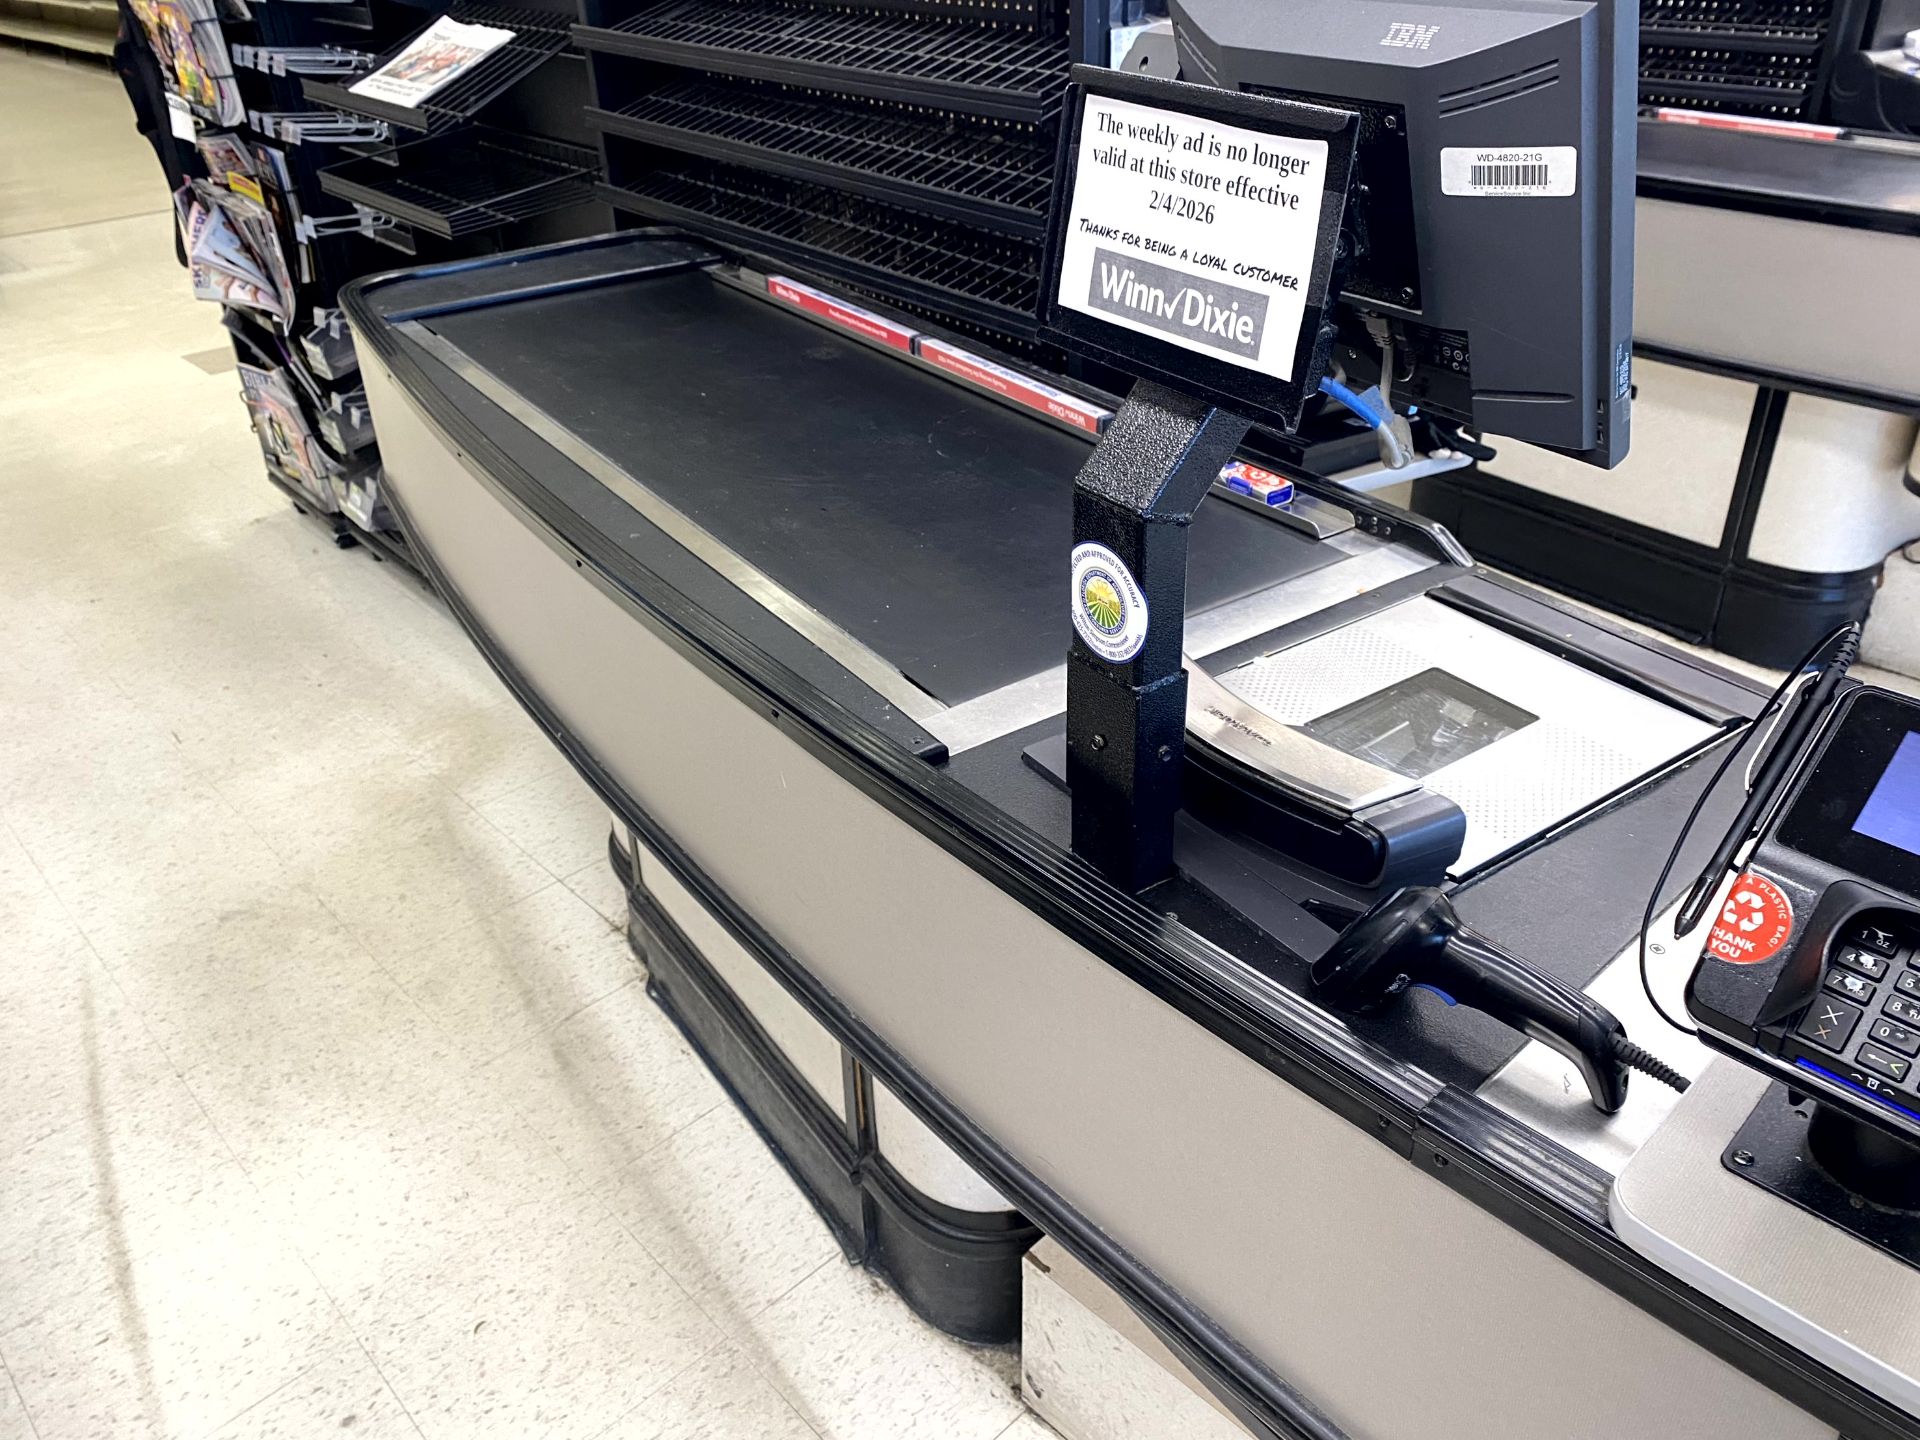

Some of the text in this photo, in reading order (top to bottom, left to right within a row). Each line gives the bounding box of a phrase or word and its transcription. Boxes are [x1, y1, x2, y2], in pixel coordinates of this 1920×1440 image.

[1380, 22, 1440, 49] IBM
[1097, 112, 1310, 178] The weekly ad is no longer
[1476, 153, 1543, 163] WD-4820-21G
[1092, 145, 1300, 210] valid at this store effective
[1149, 189, 1216, 225] 2/4/2026
[1079, 218, 1299, 291] THANKS FOR BEING A LOYAL CUSTOMER
[1759, 883, 1787, 920] PLASTIC
[1711, 926, 1757, 952] THANK
[1767, 926, 1787, 948] BAG!
[1861, 930, 1868, 939] 1
[1711, 938, 1741, 958] YOU
[1846, 953, 1856, 962] 4
[1832, 975, 1842, 984] 7
[1905, 978, 1916, 988] 5
[1892, 1001, 1903, 1011] 8
[1880, 1026, 1890, 1037] 0
